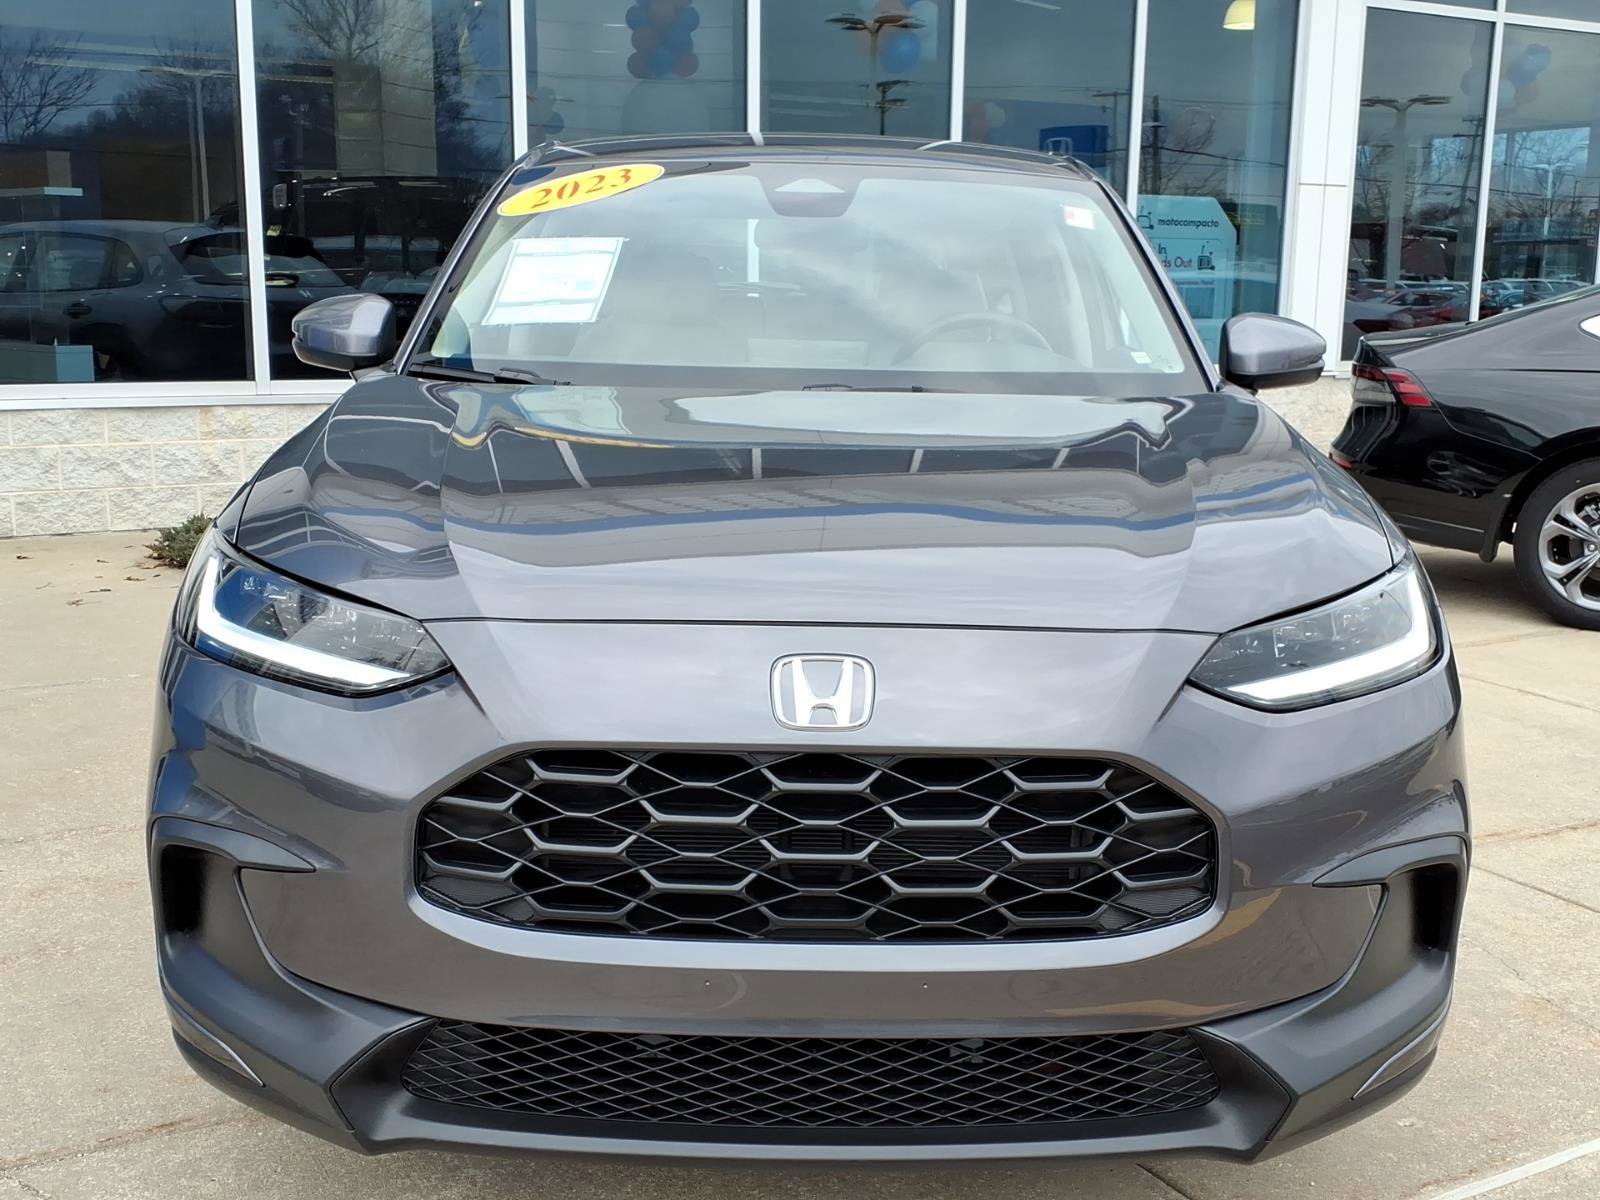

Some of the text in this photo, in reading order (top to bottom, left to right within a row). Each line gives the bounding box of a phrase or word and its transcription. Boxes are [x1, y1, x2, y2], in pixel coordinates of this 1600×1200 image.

[530, 168, 632, 209] 2023
[1157, 218, 1220, 230] motocompacto
[1174, 256, 1193, 268] Out
